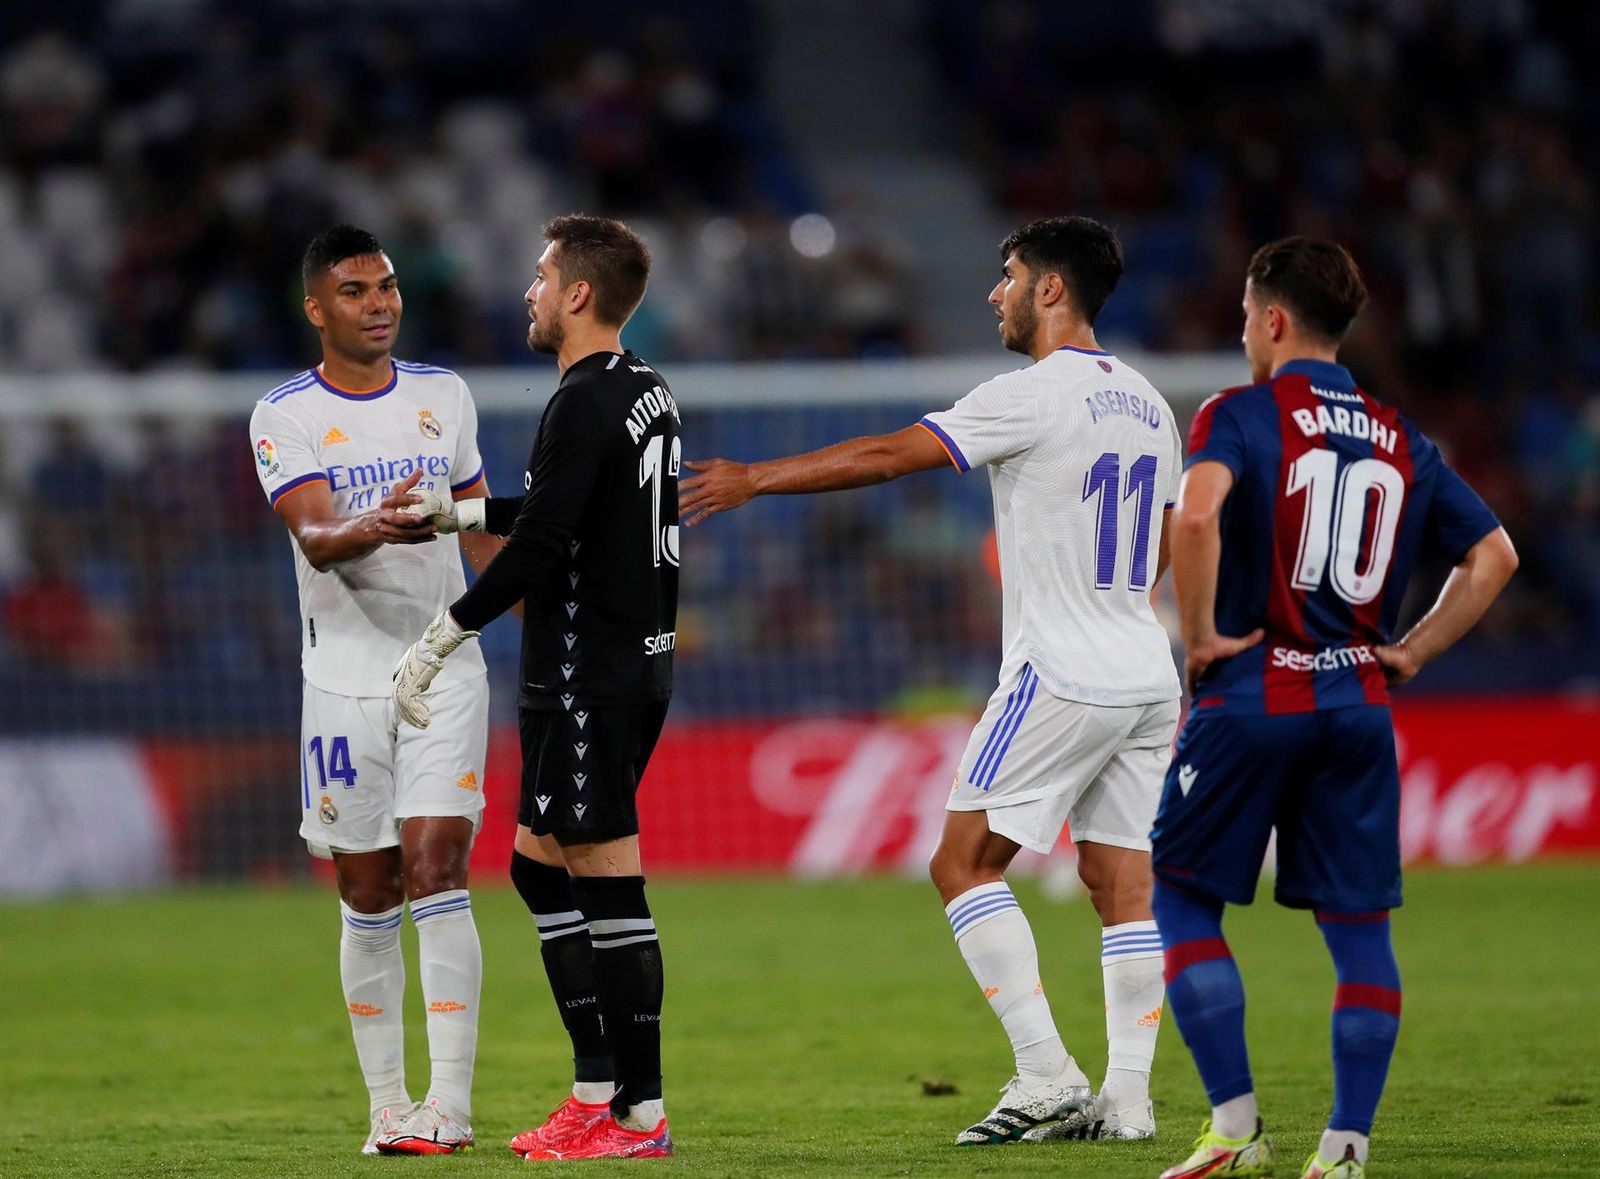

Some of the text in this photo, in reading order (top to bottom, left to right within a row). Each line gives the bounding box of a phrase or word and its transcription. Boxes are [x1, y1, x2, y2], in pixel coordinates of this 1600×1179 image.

[626, 386, 669, 444] AITOR
[1084, 390, 1160, 430] ASENSIO
[1292, 405, 1398, 455] BARDHI
[326, 453, 449, 492] Emirates
[1082, 453, 1158, 591] 11
[1286, 448, 1405, 605] 10
[308, 735, 358, 789] 14
